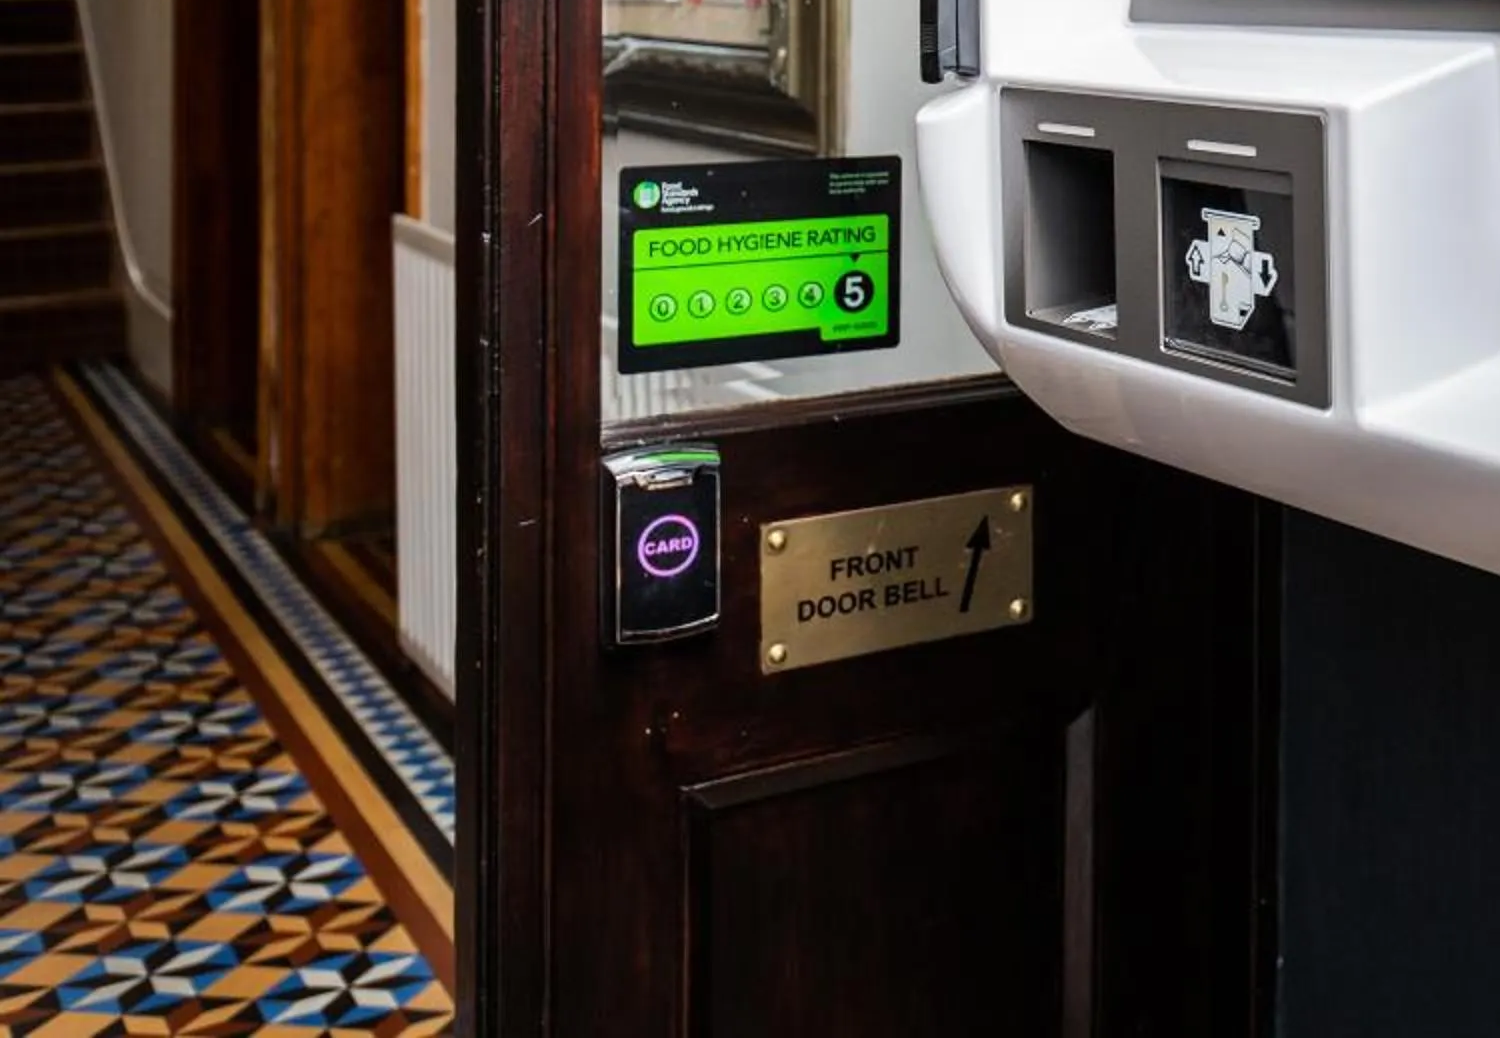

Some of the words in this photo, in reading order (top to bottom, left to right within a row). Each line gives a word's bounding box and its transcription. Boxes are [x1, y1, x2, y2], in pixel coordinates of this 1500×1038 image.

[649, 236, 712, 257] FOOD
[717, 232, 801, 252] HYGIENE
[806, 226, 876, 245] RATING
[656, 299, 669, 317] 0
[732, 293, 745, 310] 2
[768, 289, 782, 306] 3
[804, 283, 818, 301] 4
[843, 276, 865, 308] 5
[643, 536, 693, 556] CARD
[830, 546, 919, 581] FRONT
[797, 590, 876, 622] DOOR
[884, 576, 950, 606] BELL
